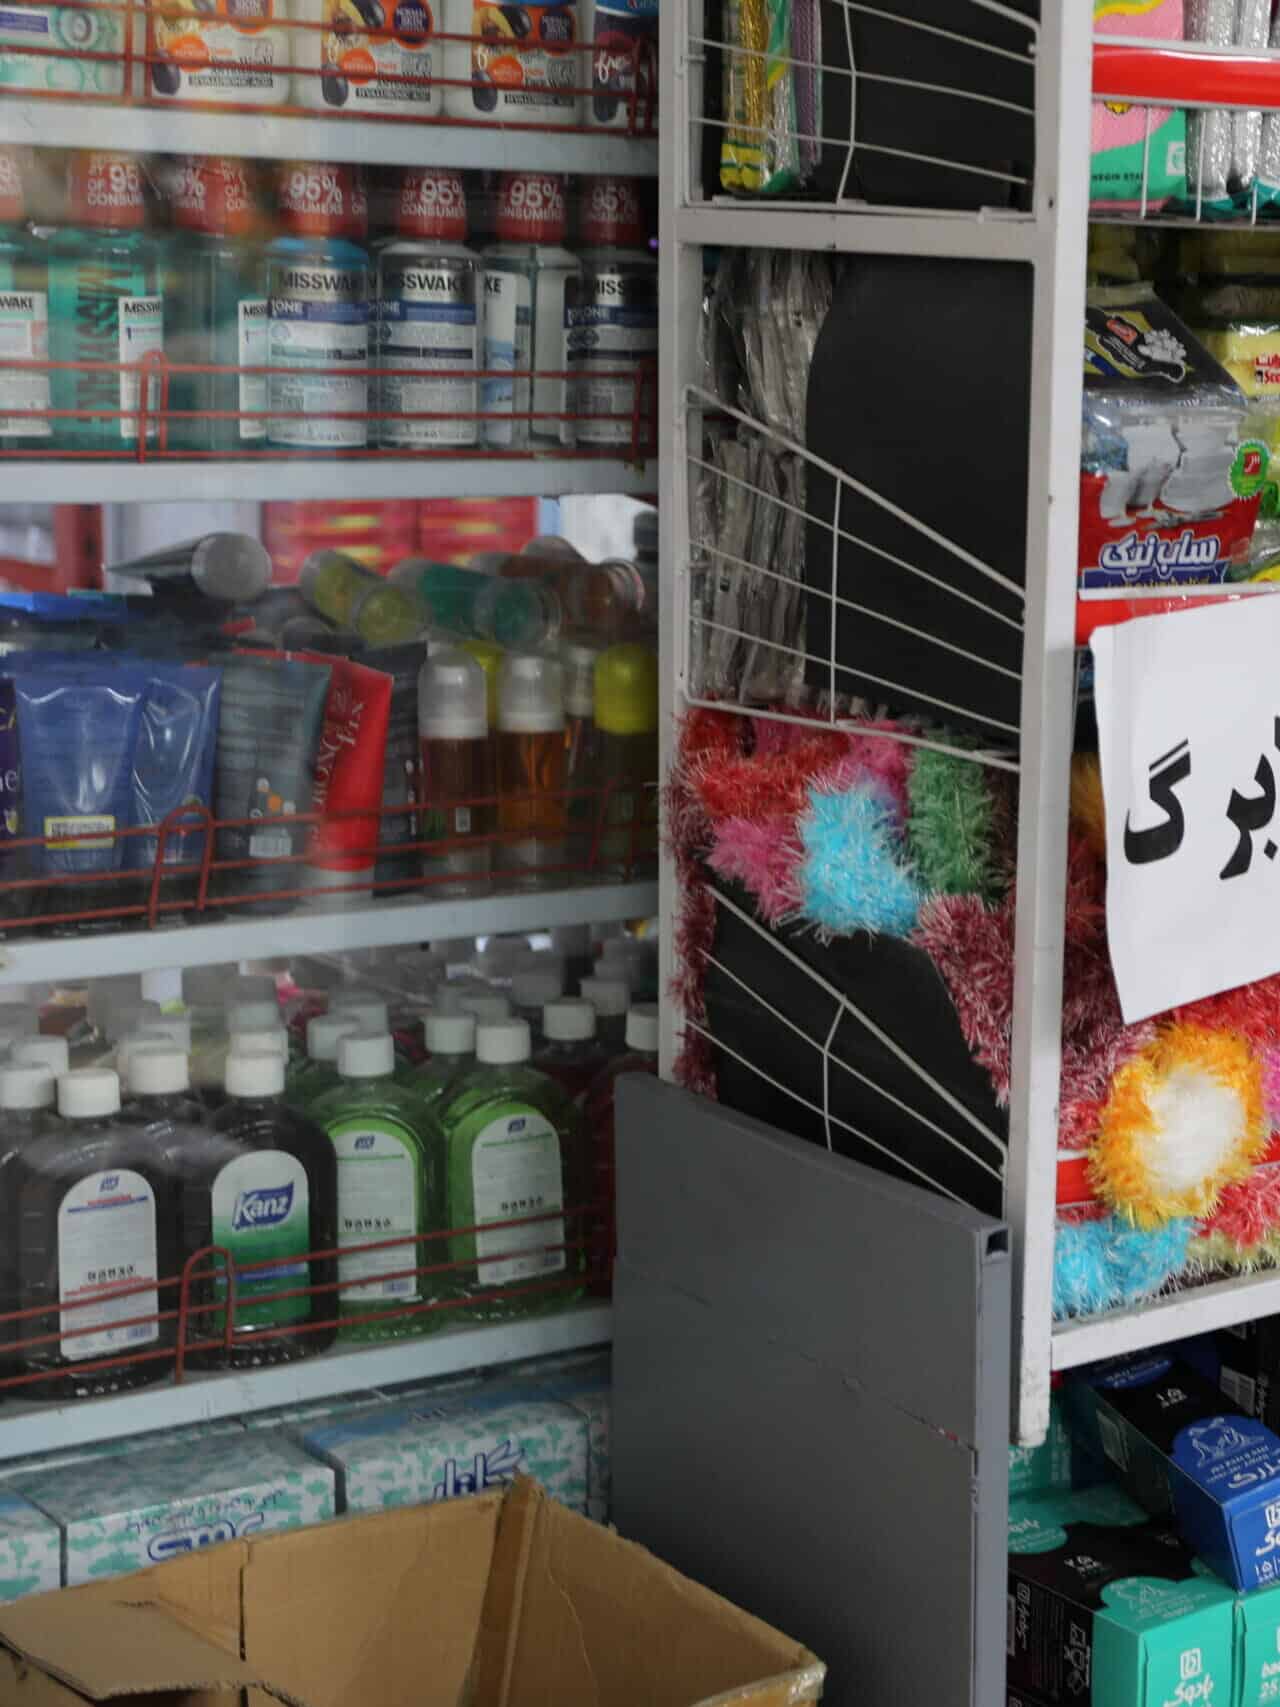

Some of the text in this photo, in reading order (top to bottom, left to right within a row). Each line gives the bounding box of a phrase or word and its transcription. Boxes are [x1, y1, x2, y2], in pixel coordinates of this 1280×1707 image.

[511, 180, 563, 212] 95%
[1101, 531, 1220, 581] ساب نیک
[235, 1190, 289, 1227] Kanz
